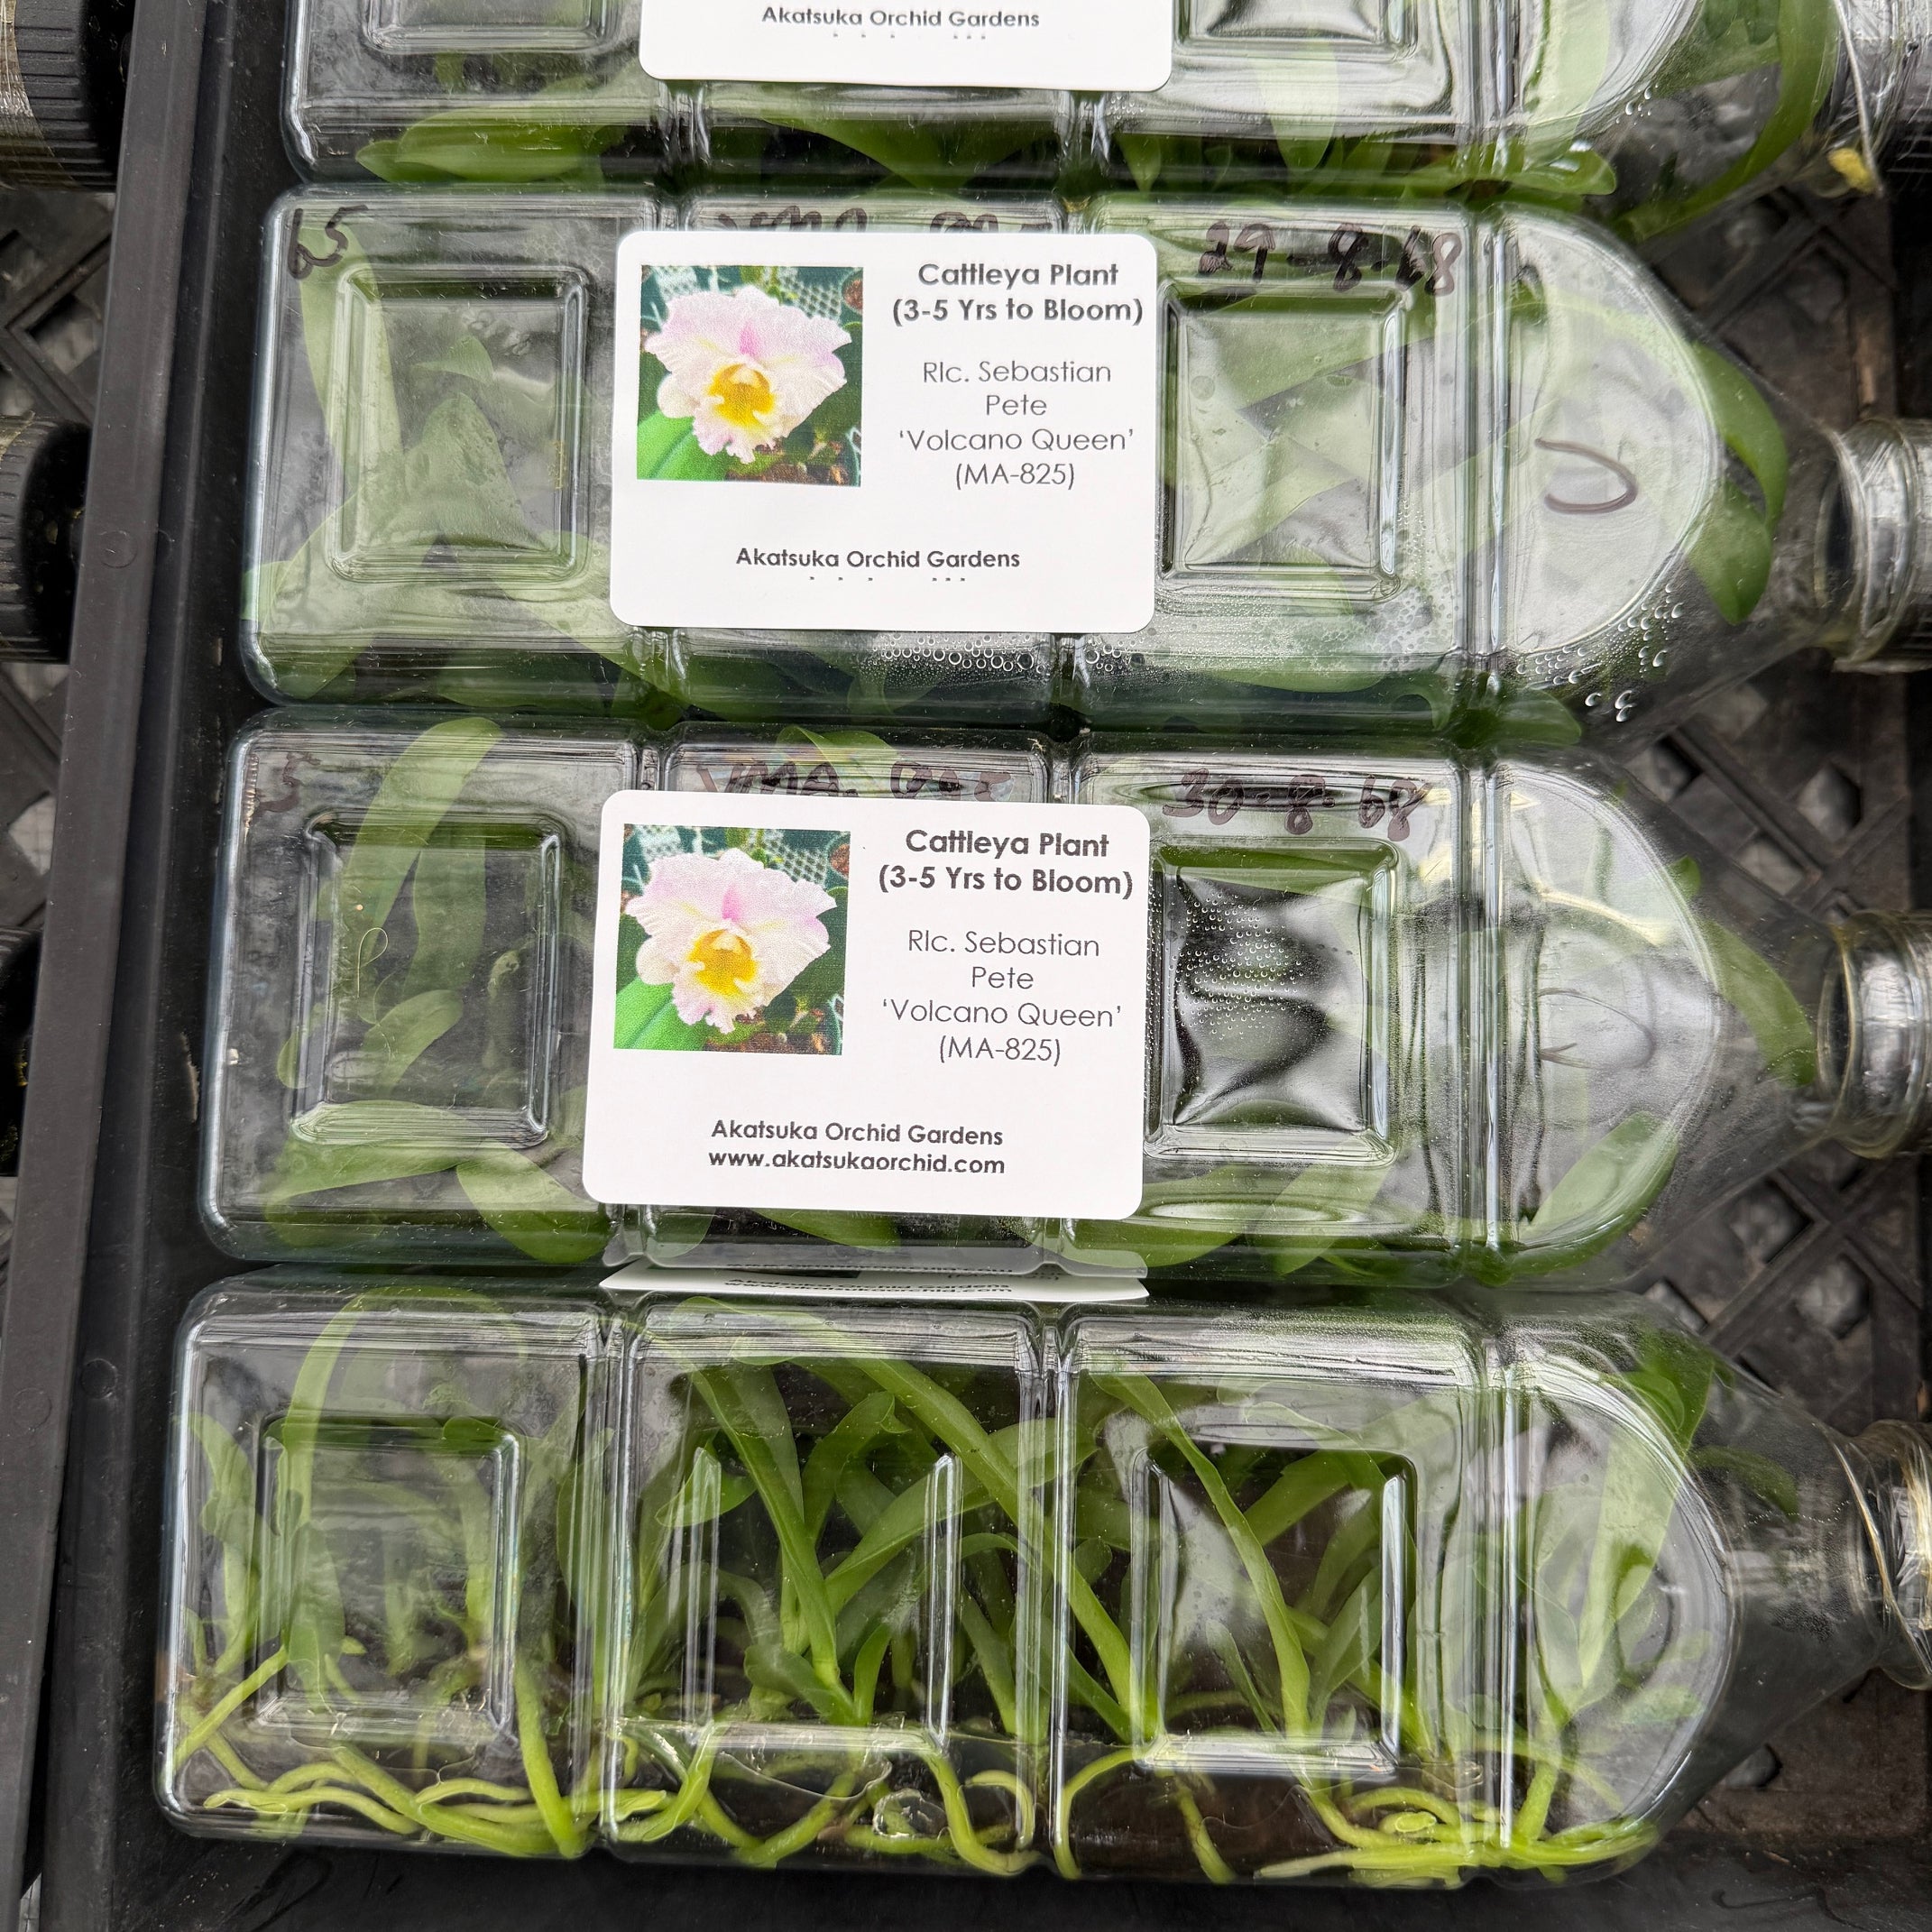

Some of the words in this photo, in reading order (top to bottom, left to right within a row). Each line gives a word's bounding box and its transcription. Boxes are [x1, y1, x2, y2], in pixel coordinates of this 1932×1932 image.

[762, 6, 862, 25] Akatsuka
[869, 10, 942, 26] Orchid
[948, 11, 1040, 27] Gardens
[918, 262, 1040, 290] Cattleya
[1050, 263, 1119, 286] Plant
[892, 299, 948, 327] (3-5
[958, 299, 998, 321] Yrs
[1006, 298, 1034, 320] to
[1044, 298, 1143, 326] Bloom)
[978, 360, 1111, 382] Sebastian
[986, 393, 1047, 416] Pete
[956, 462, 1074, 491] (MA-825)
[735, 547, 840, 567] Akatsuka
[846, 550, 920, 568] Orchid
[926, 550, 1020, 568] Gardens
[906, 829, 1029, 860] Cattleya
[1039, 833, 1109, 858] Plant
[879, 864, 935, 894] (3-5
[945, 866, 986, 890] Yrs
[993, 867, 1022, 891] to
[1032, 869, 1133, 900] Bloom)
[964, 930, 1099, 957] Sebastian
[971, 966, 1034, 989] Pete
[940, 1035, 1061, 1067] (MA-825)
[711, 1119, 818, 1140] Akatsuka
[824, 1122, 901, 1143] Orchid
[907, 1124, 1003, 1145] Gardens
[708, 1149, 1005, 1174] www.akatsukaorchid.com
